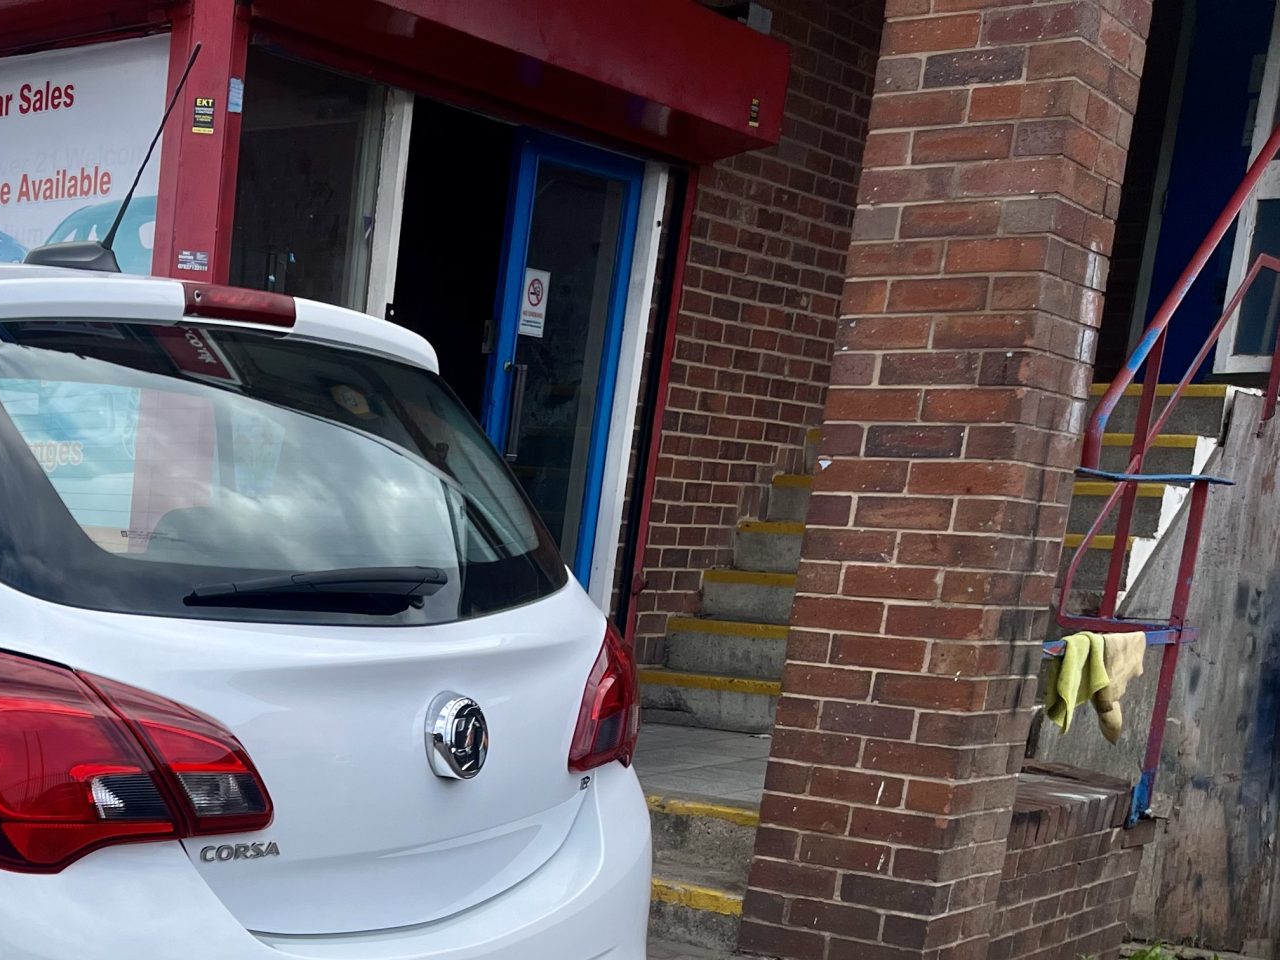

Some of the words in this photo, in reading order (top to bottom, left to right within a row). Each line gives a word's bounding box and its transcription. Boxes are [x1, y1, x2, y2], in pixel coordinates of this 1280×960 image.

[19, 81, 75, 115] Sales
[196, 98, 214, 107] EKT
[16, 165, 112, 203] Available
[200, 841, 280, 862] CORSA
